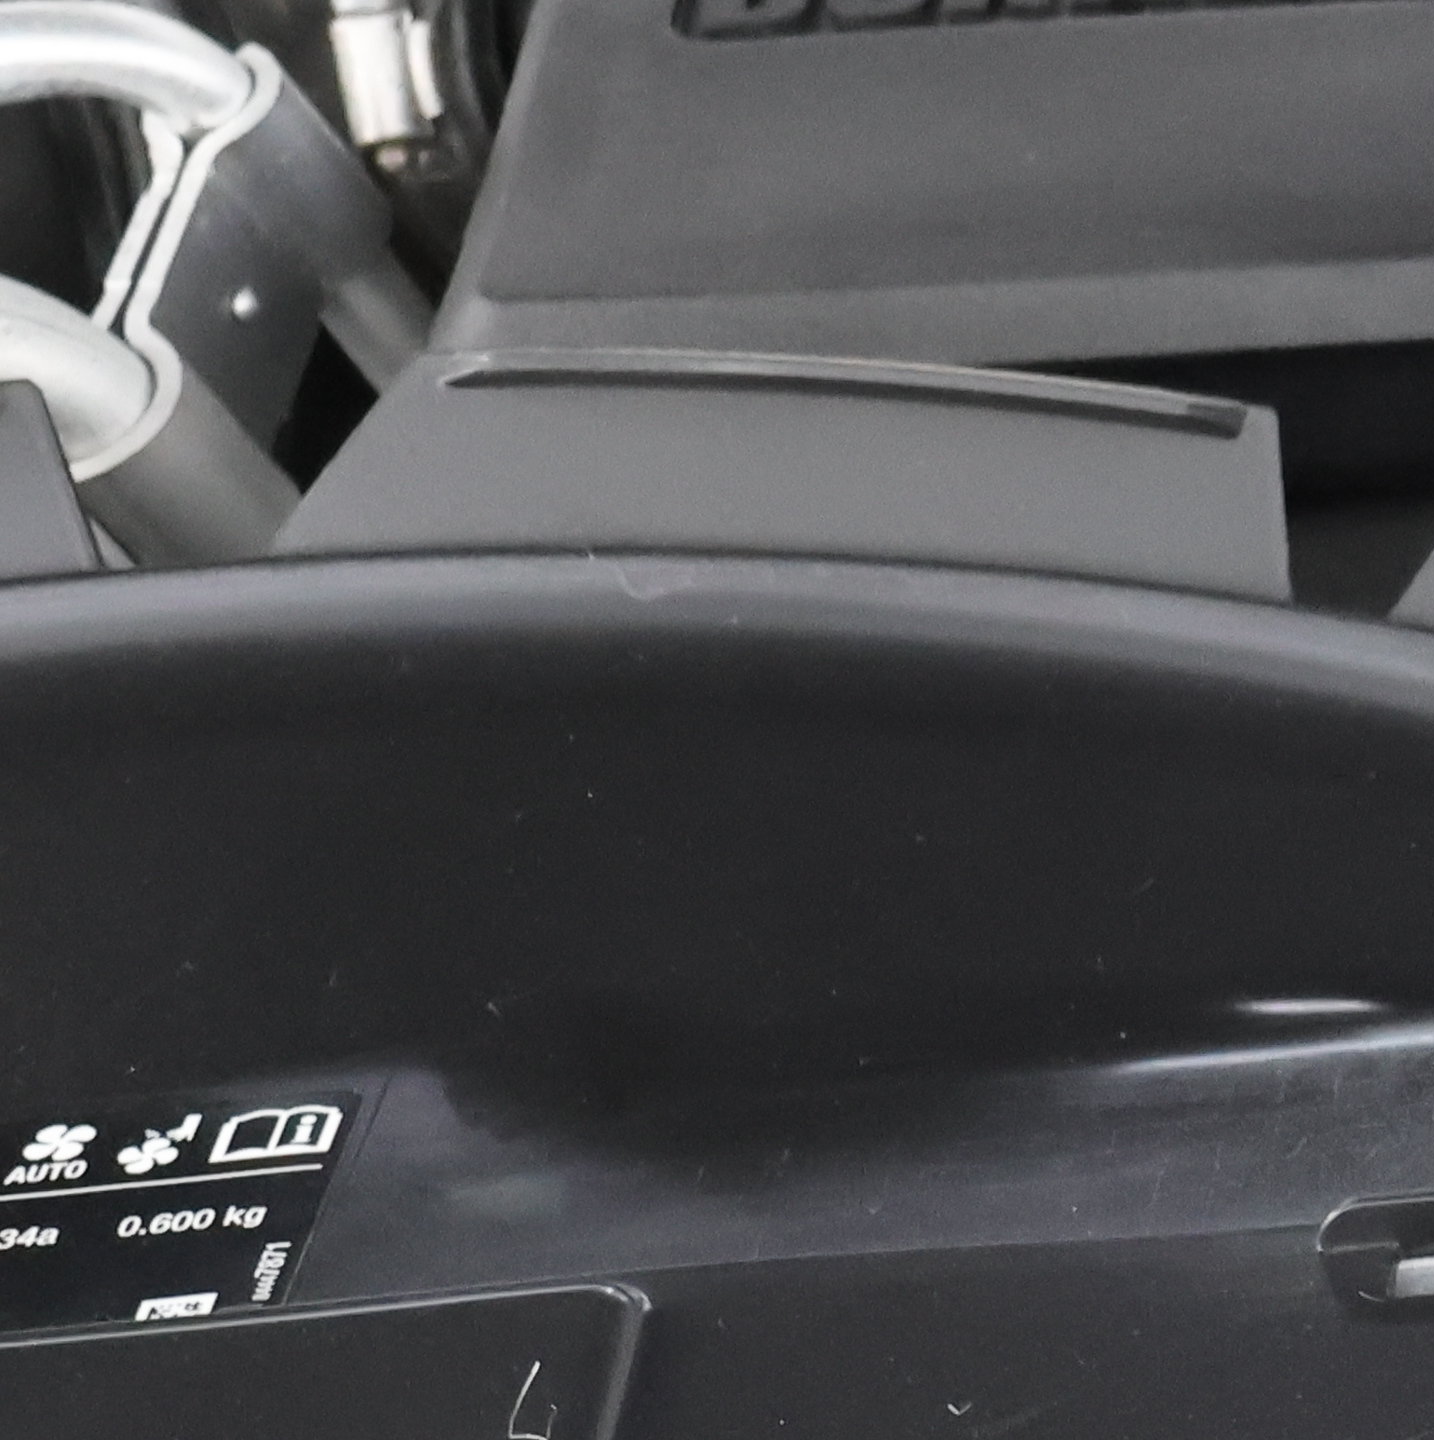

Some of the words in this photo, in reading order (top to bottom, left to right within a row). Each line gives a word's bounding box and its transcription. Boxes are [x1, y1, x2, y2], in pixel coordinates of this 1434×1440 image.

[3, 1158, 89, 1186] AUTO
[117, 1208, 216, 1239] 0.600
[222, 1205, 268, 1229] kg
